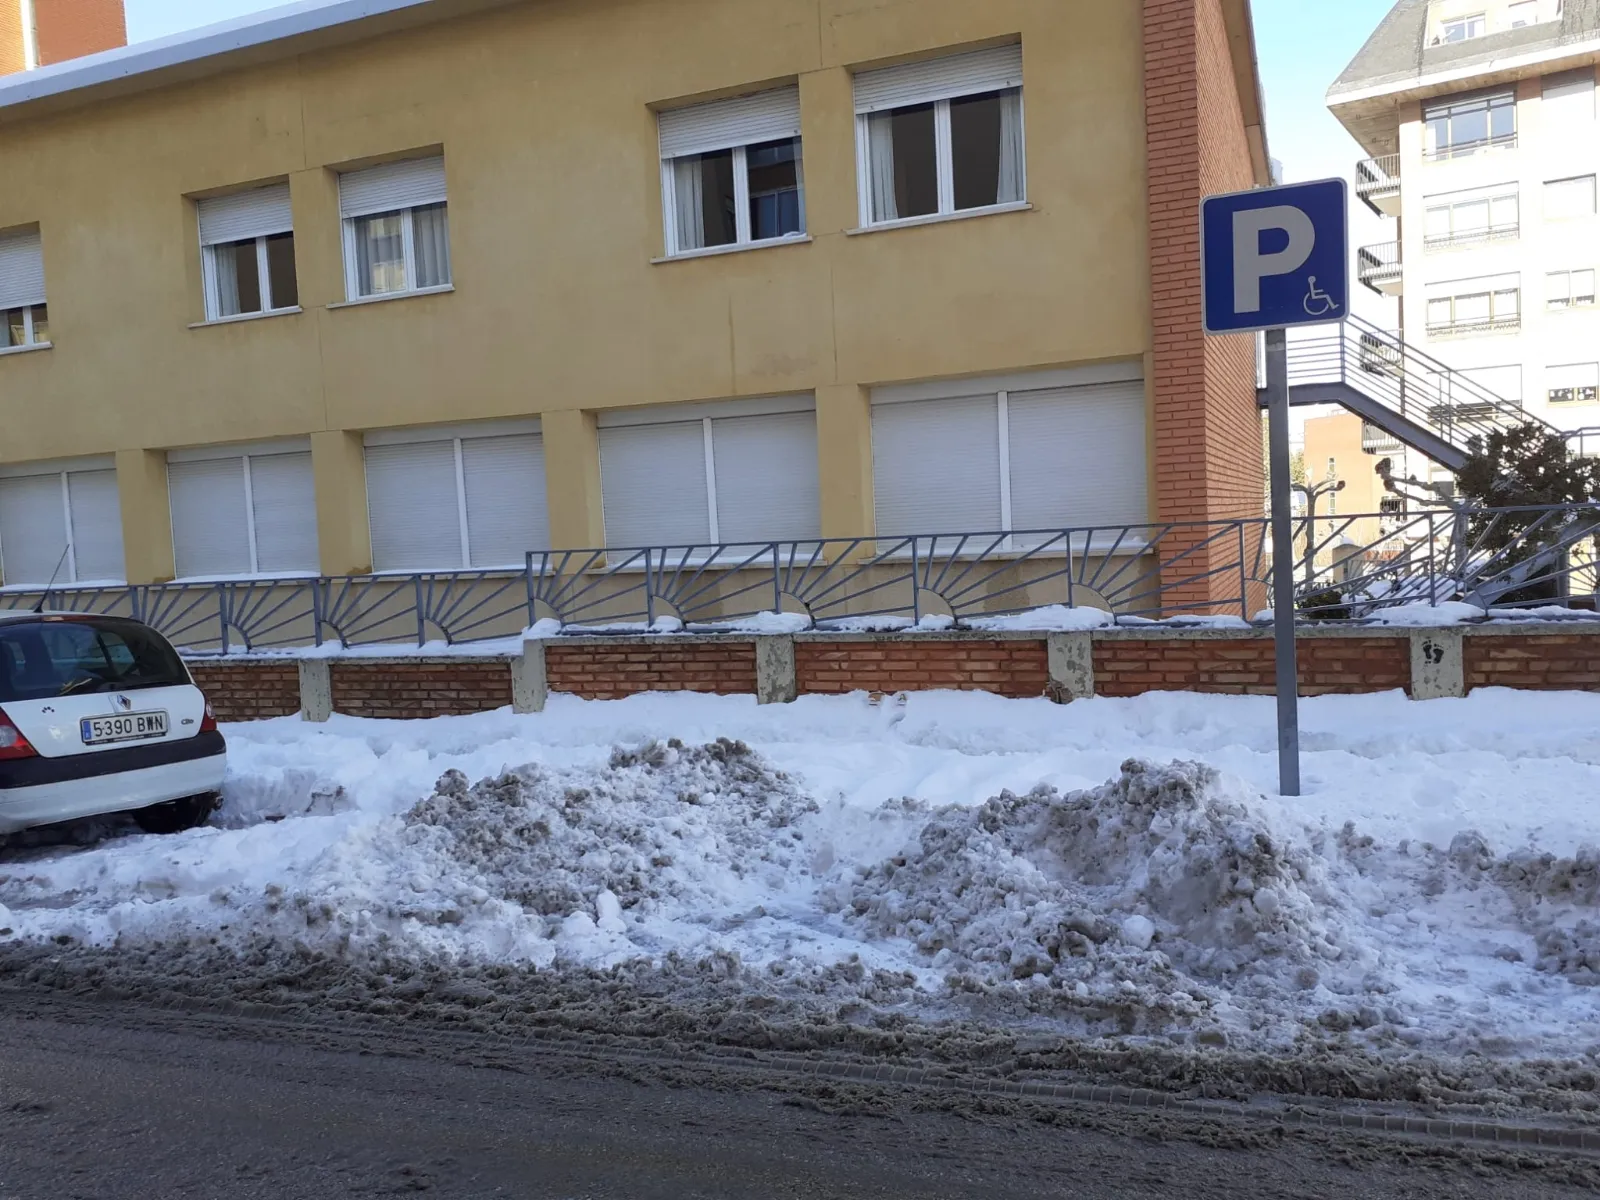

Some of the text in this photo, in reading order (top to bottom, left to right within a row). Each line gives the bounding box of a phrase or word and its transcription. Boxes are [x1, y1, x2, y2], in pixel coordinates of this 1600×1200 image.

[1232, 205, 1316, 314] P
[93, 715, 164, 737] 5390 BWN
